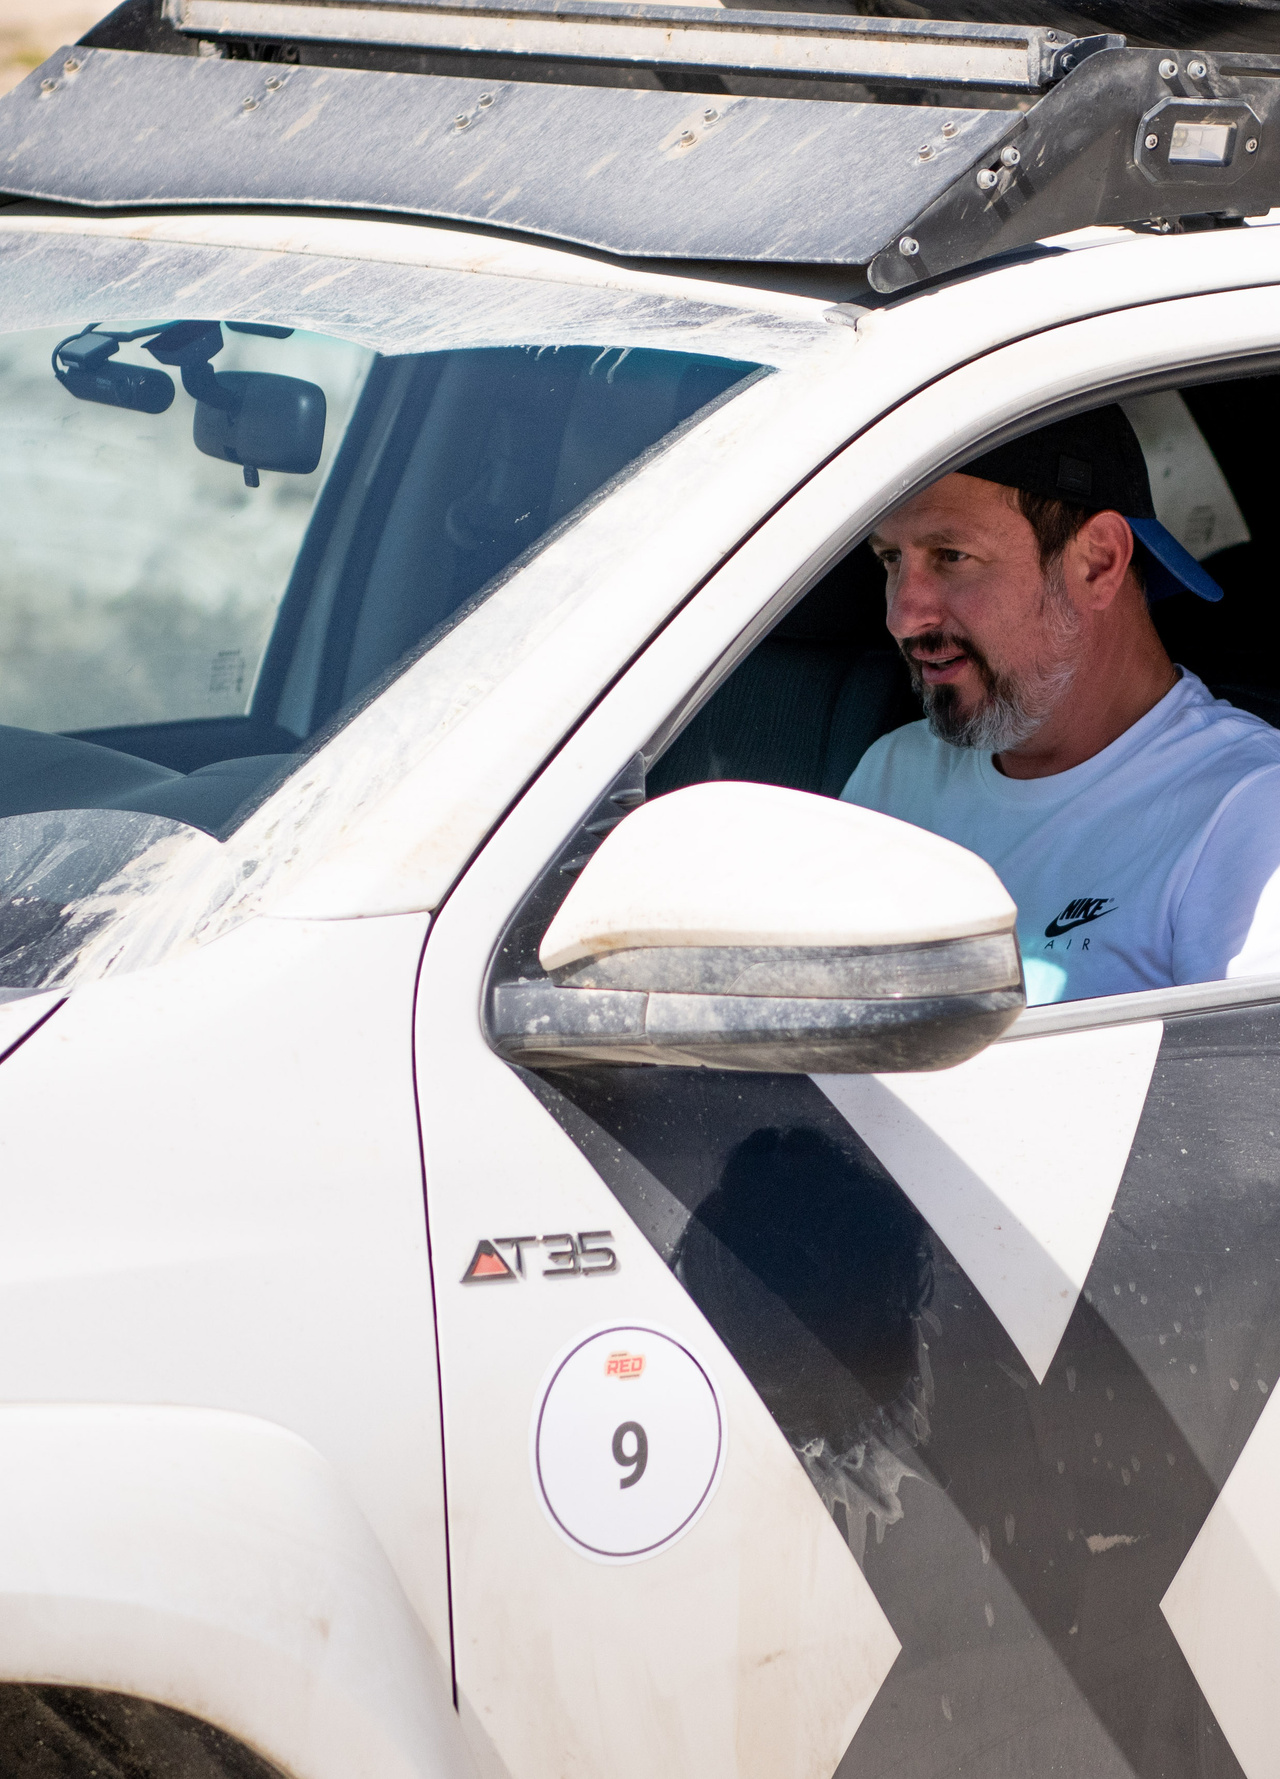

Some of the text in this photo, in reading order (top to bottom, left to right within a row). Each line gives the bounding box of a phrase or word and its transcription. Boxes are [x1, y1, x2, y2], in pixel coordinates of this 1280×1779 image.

[1059, 898, 1109, 920] NIKE
[1044, 938, 1090, 950] AIR
[460, 1230, 619, 1283] AT35
[607, 1357, 643, 1375] RED
[611, 1421, 648, 1490] 9
